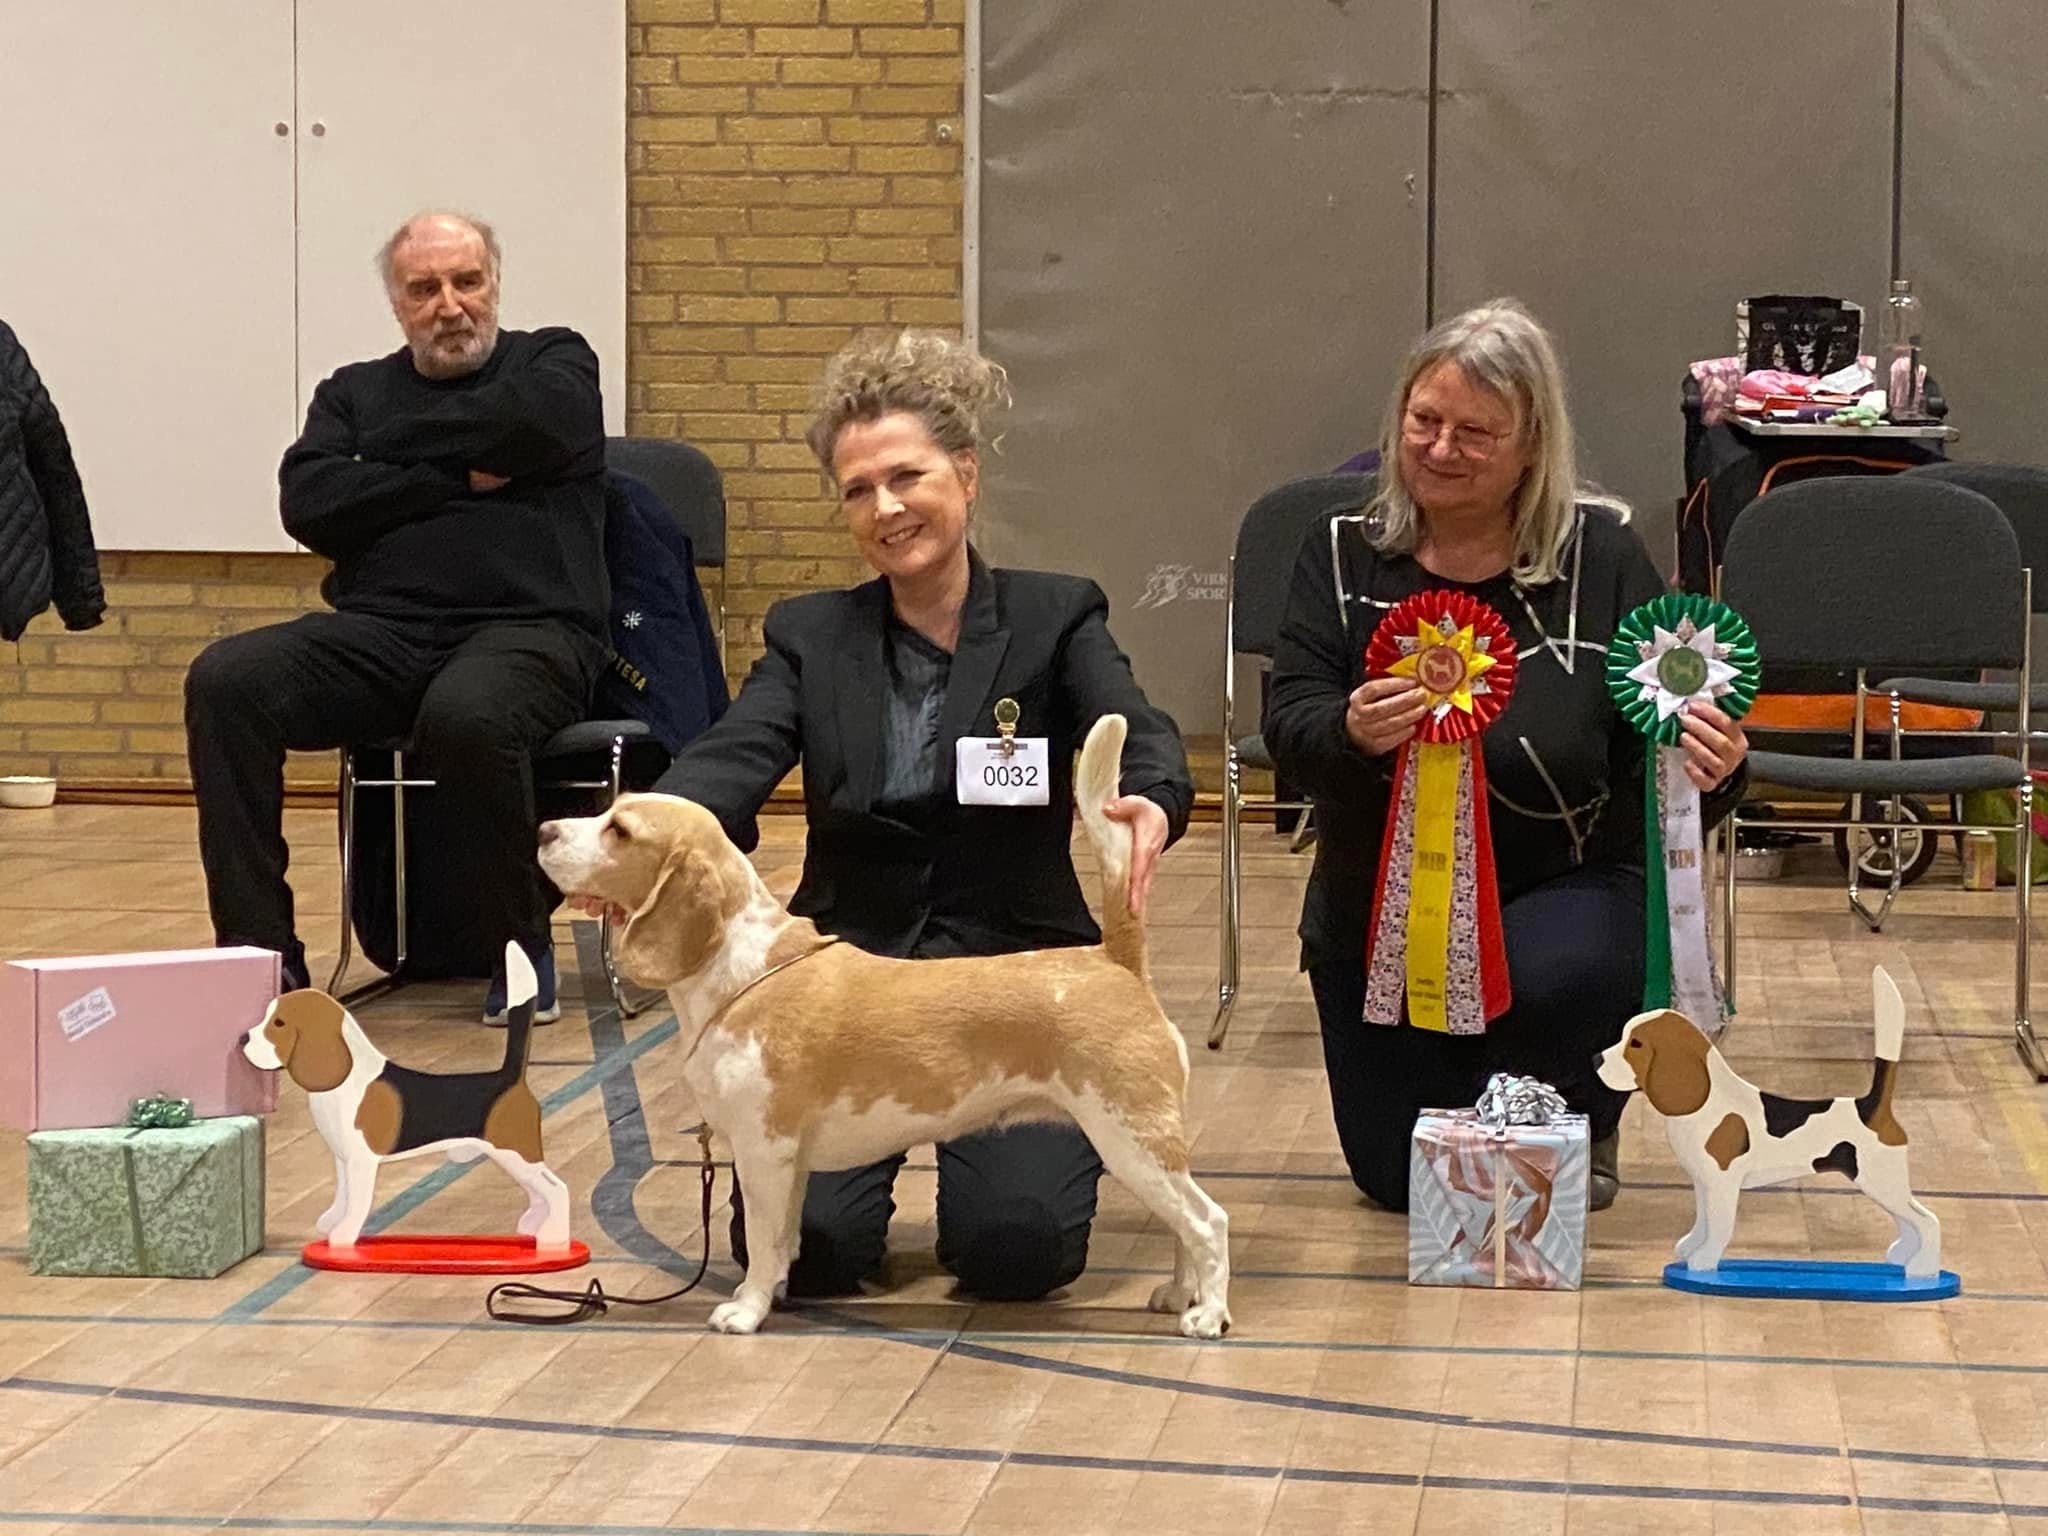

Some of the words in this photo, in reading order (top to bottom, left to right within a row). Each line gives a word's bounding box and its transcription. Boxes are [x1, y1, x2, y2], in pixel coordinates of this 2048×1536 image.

[1192, 573, 1226, 585] VIRK
[1186, 586, 1225, 599] SPOR
[983, 766, 1038, 787] 0032
